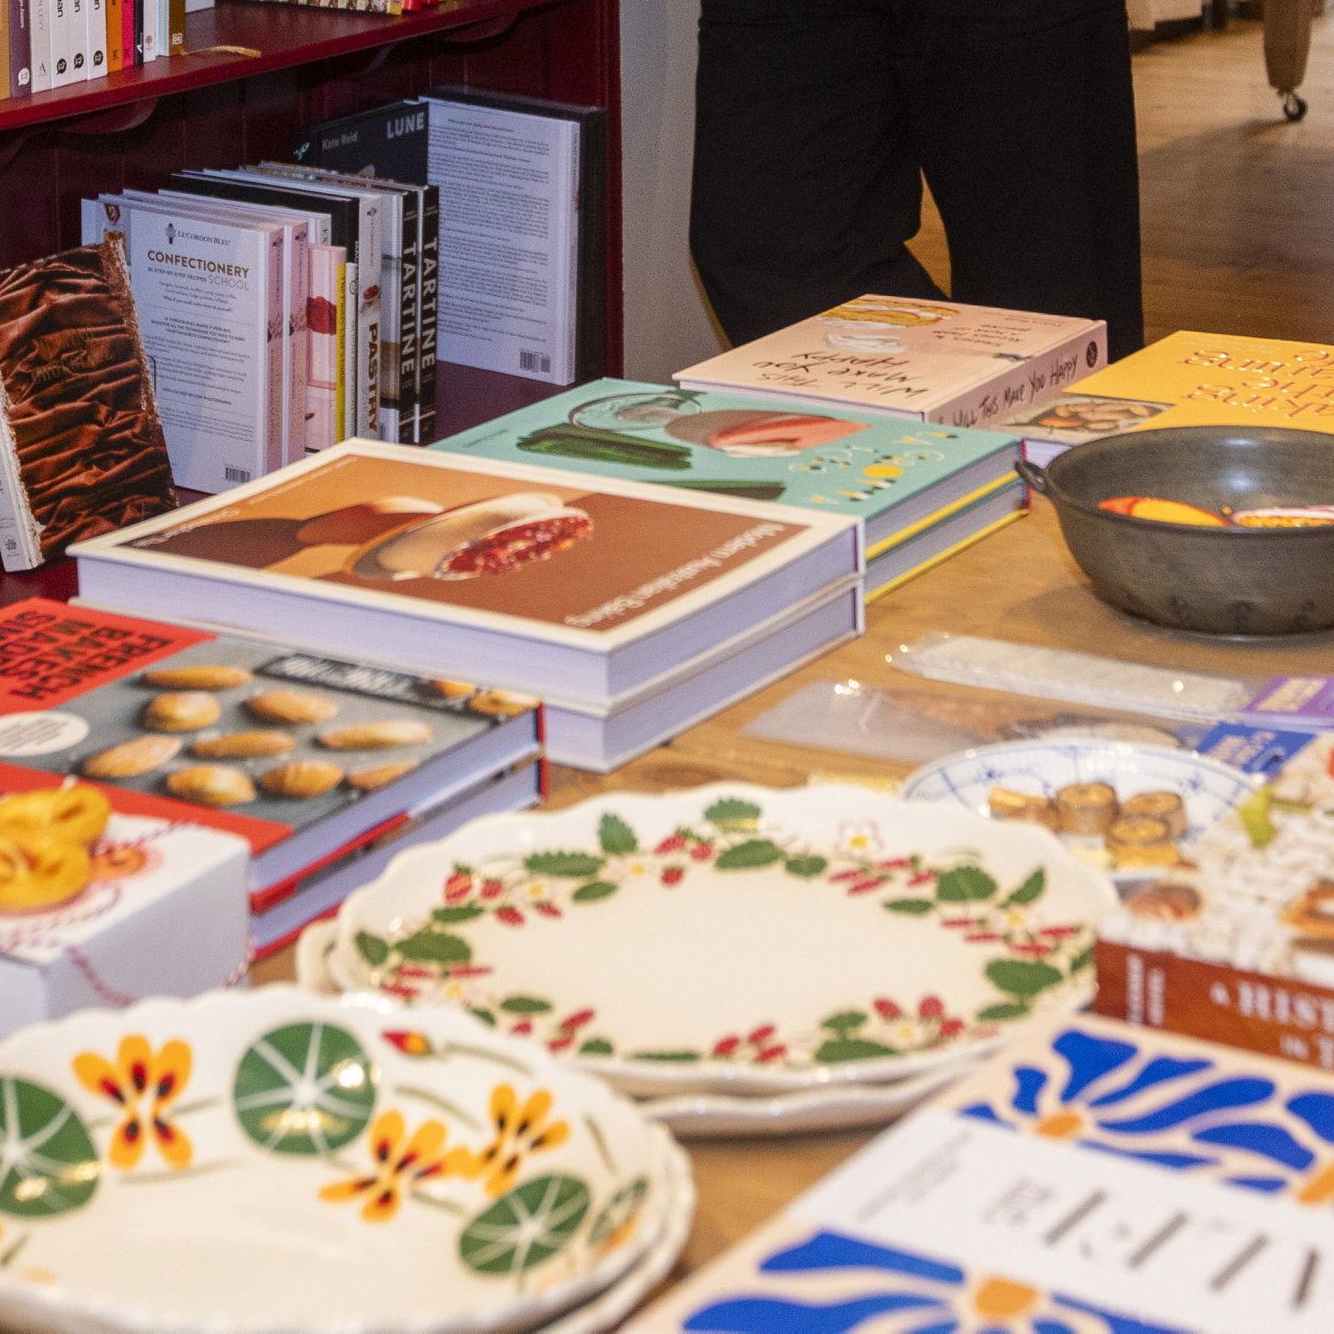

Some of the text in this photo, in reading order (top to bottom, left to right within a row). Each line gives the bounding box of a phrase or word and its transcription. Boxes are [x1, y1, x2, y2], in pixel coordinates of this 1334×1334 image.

[386, 110, 425, 139] LUNE
[147, 250, 250, 278] CONFECTIONERY
[401, 241, 417, 375] TARTINE
[368, 322, 378, 433] PASTRY
[9, 635, 174, 702] FRENCH
[1210, 983, 1230, 1007] A
